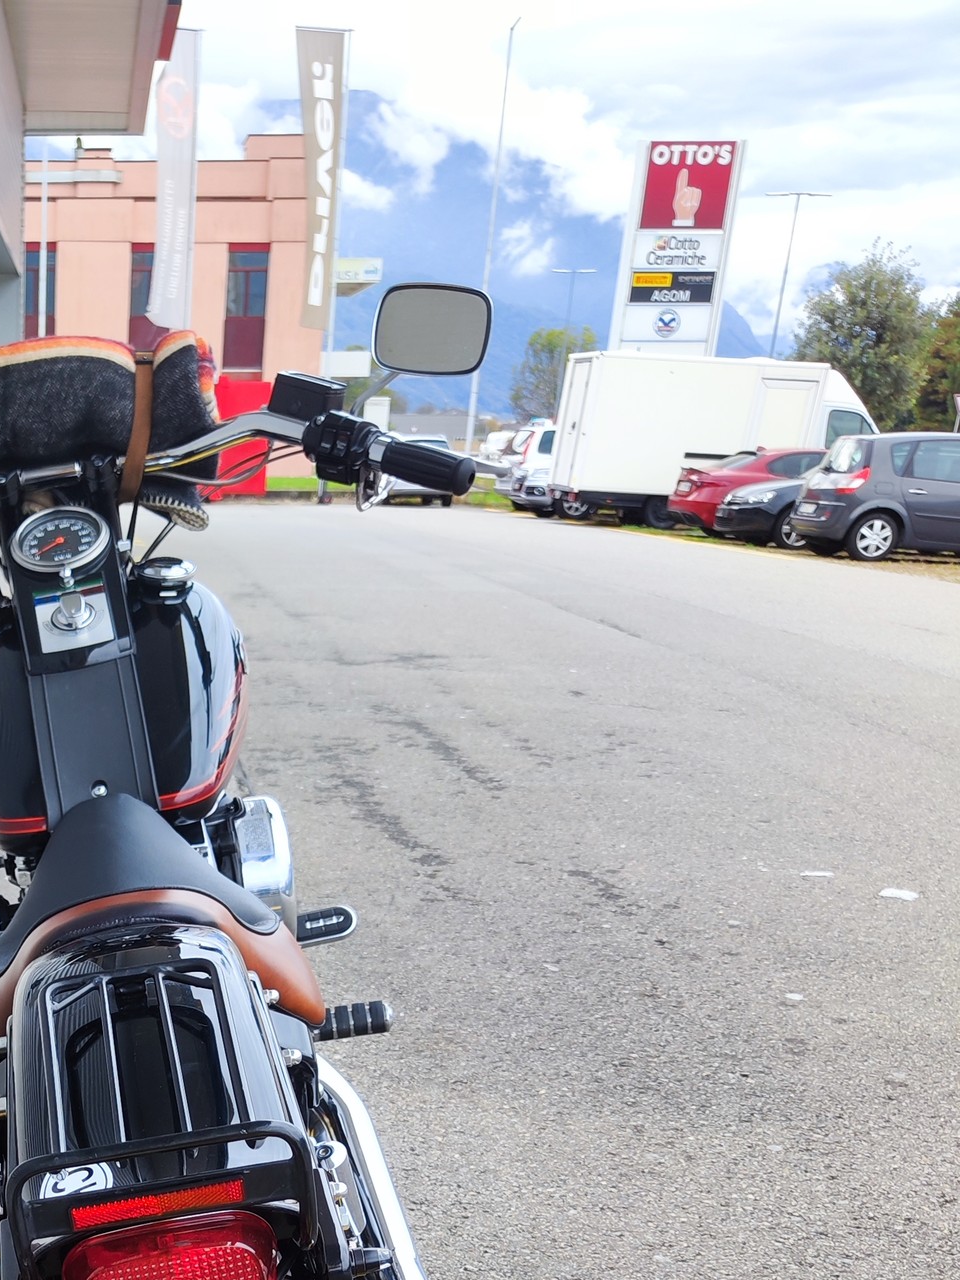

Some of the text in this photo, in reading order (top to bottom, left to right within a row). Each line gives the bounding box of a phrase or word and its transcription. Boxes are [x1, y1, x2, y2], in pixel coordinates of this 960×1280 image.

[651, 144, 733, 166] OTTO'S
[667, 236, 701, 251] Cotto
[645, 251, 707, 266] Ceramiche
[650, 289, 691, 302] AGOM
